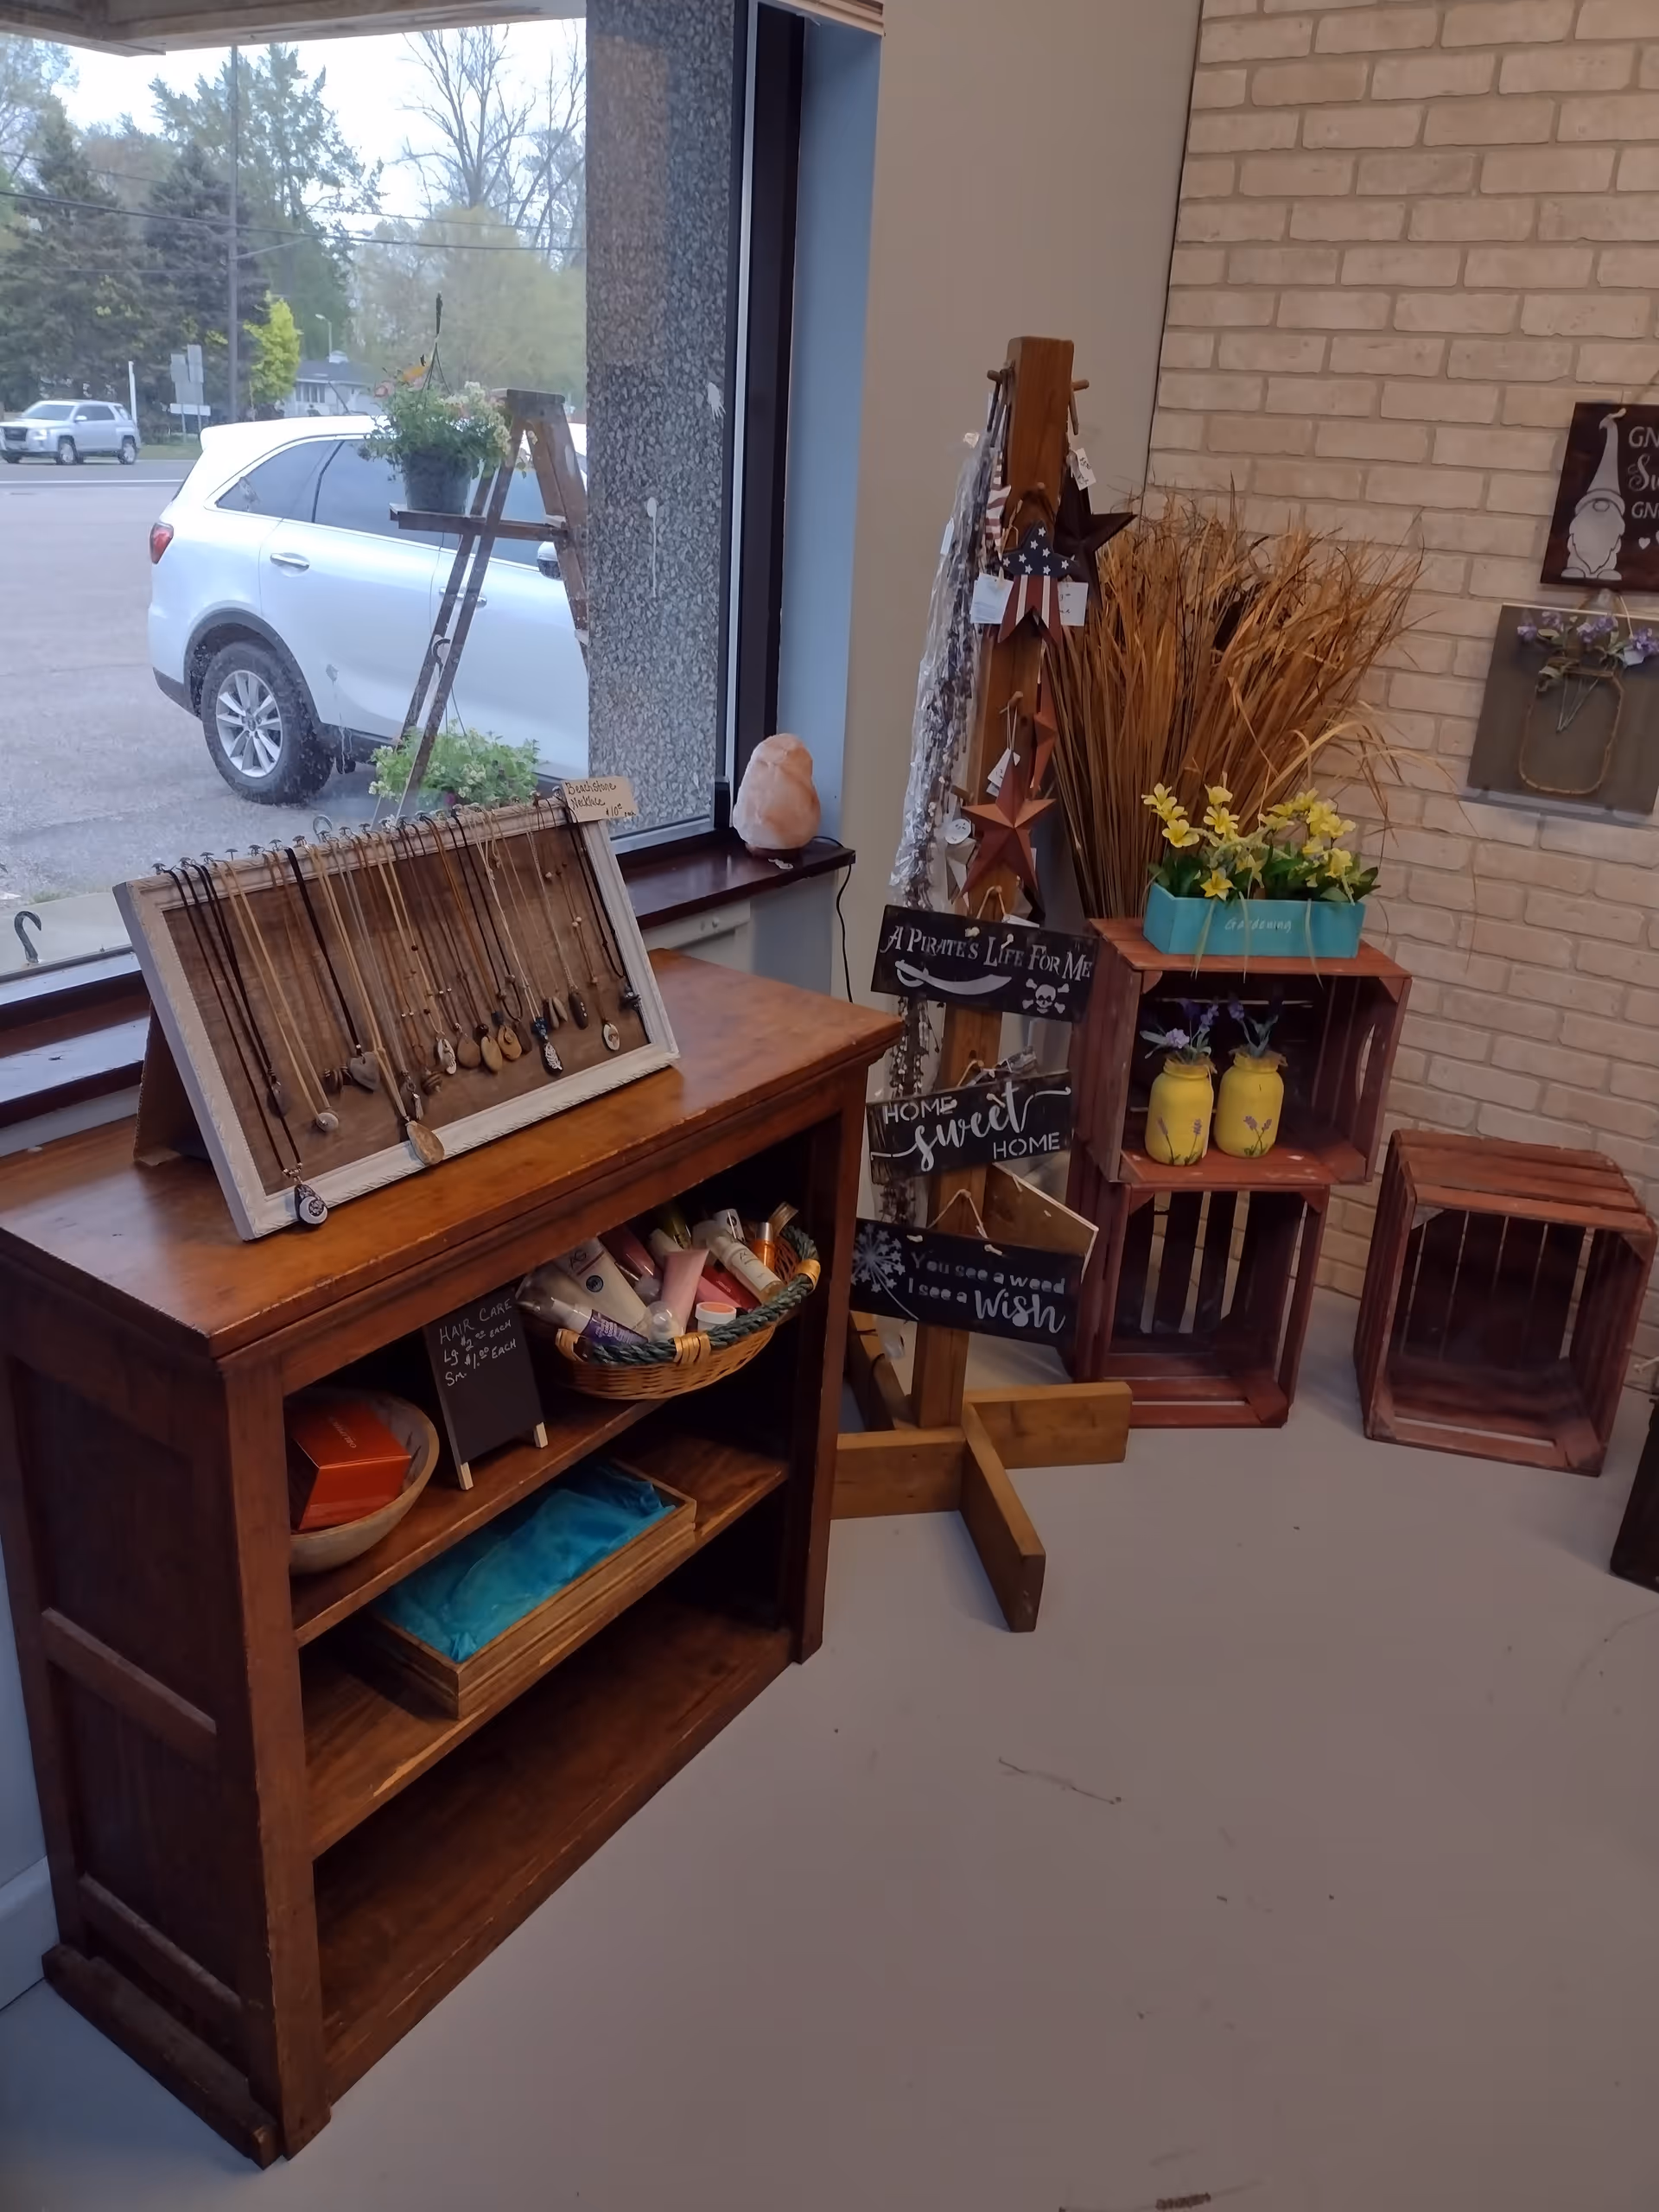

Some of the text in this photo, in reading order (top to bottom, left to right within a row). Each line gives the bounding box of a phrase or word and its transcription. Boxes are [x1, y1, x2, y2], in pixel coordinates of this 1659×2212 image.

[565, 780, 617, 795] Beachstone
[570, 795, 606, 810] Necklace
[880, 925, 904, 954] A
[1028, 944, 1060, 976] FOR
[1062, 950, 1093, 982] ME
[884, 1096, 954, 1124] HOME
[895, 1080, 1042, 1172] sweet
[993, 1131, 1061, 1160] HOME
[910, 1250, 1066, 1295] You see a weed
[908, 1277, 1066, 1334] I see a Wish
[439, 1298, 512, 1345] HAIR CARE
[489, 1319, 512, 1338] EACH
[491, 1338, 517, 1359] EACH
